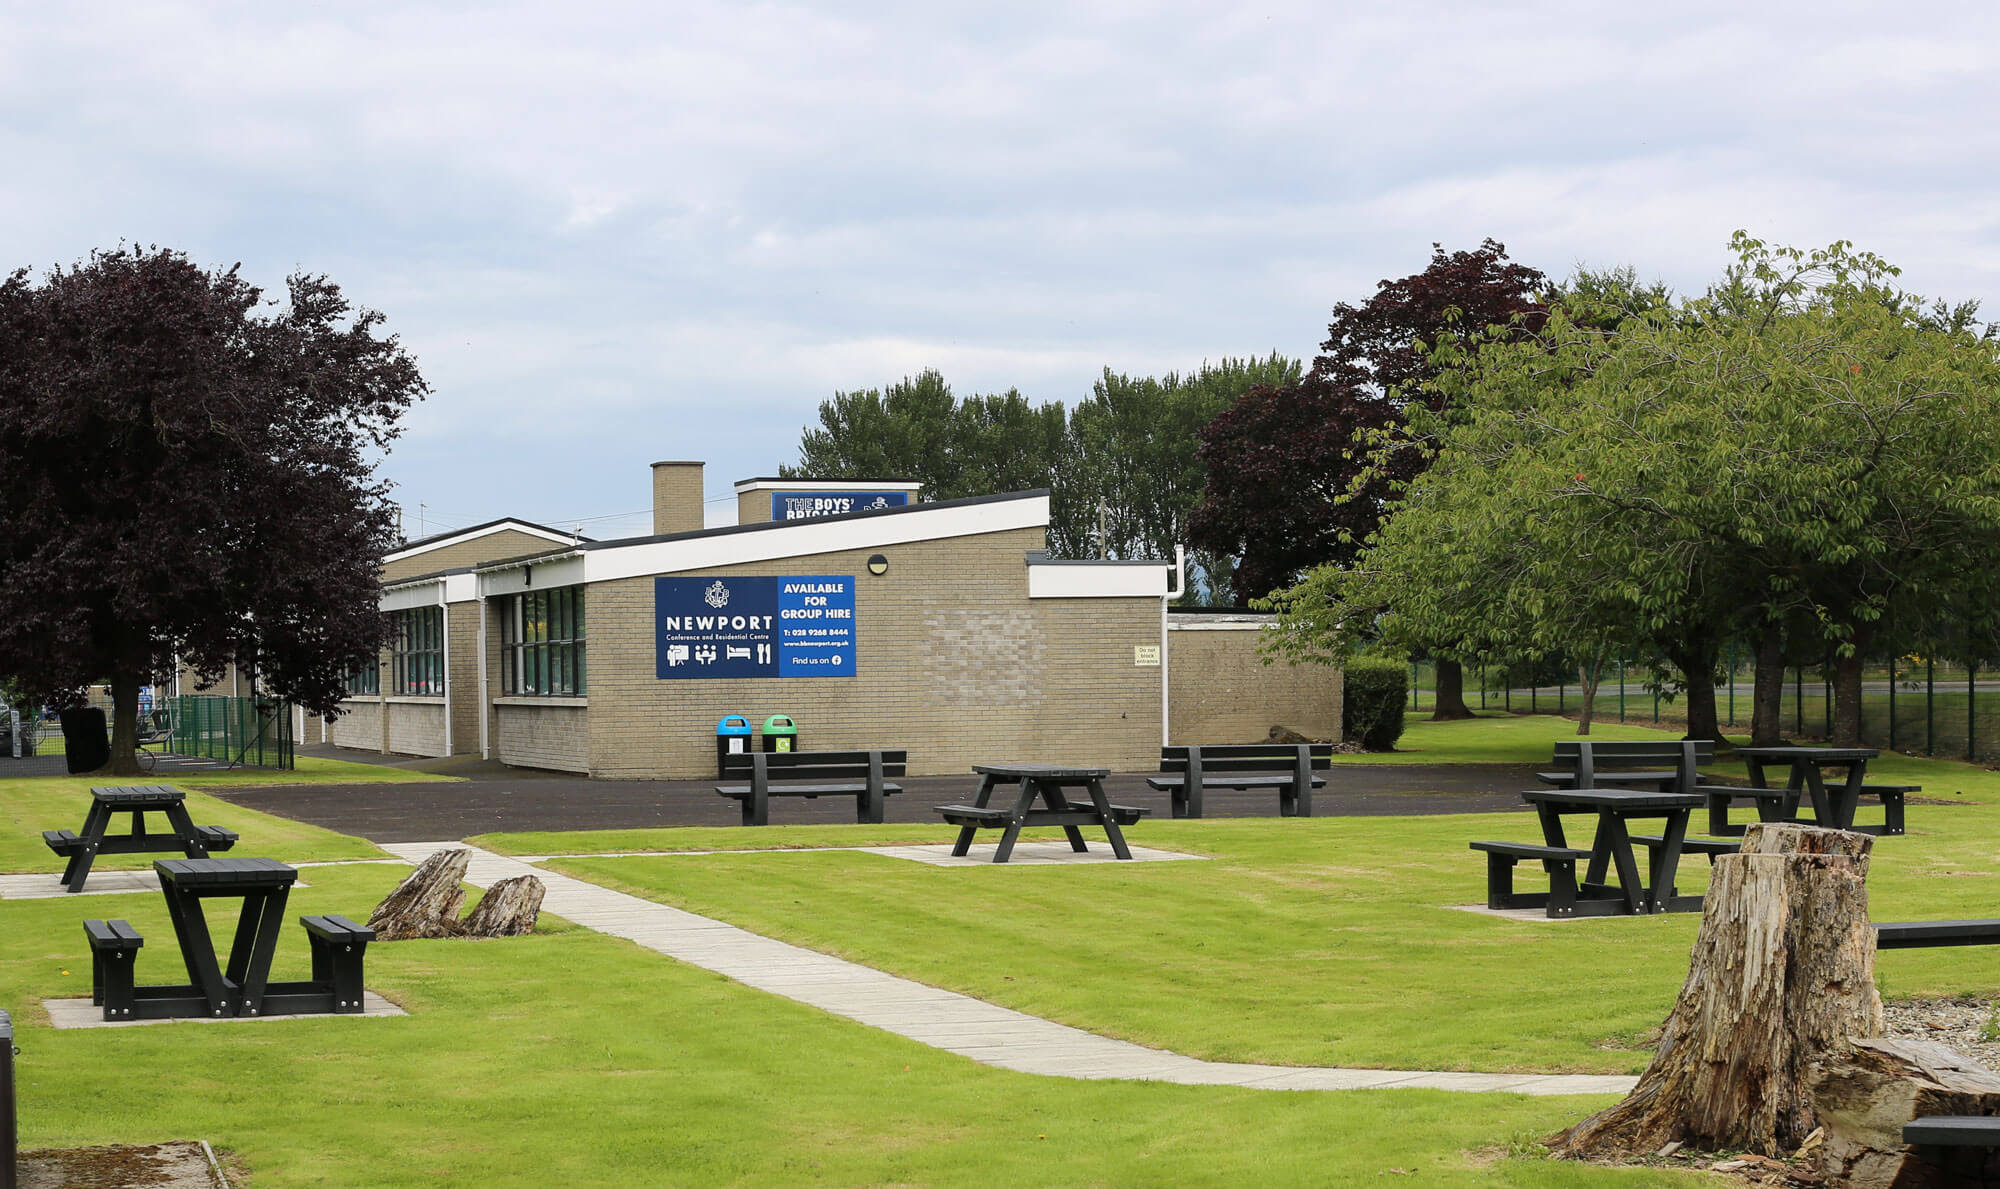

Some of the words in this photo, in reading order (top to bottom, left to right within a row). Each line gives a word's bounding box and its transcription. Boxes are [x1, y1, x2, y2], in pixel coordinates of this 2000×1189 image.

[783, 583, 844, 594] AVAILABLE
[804, 596, 827, 606] FOR
[781, 609, 823, 619] GROUP
[825, 609, 851, 619] HIRE
[666, 615, 773, 631] NEWPORT
[666, 633, 700, 641] Conference
[702, 633, 714, 641] and
[715, 633, 748, 641] Residential
[792, 657, 808, 665] Find
